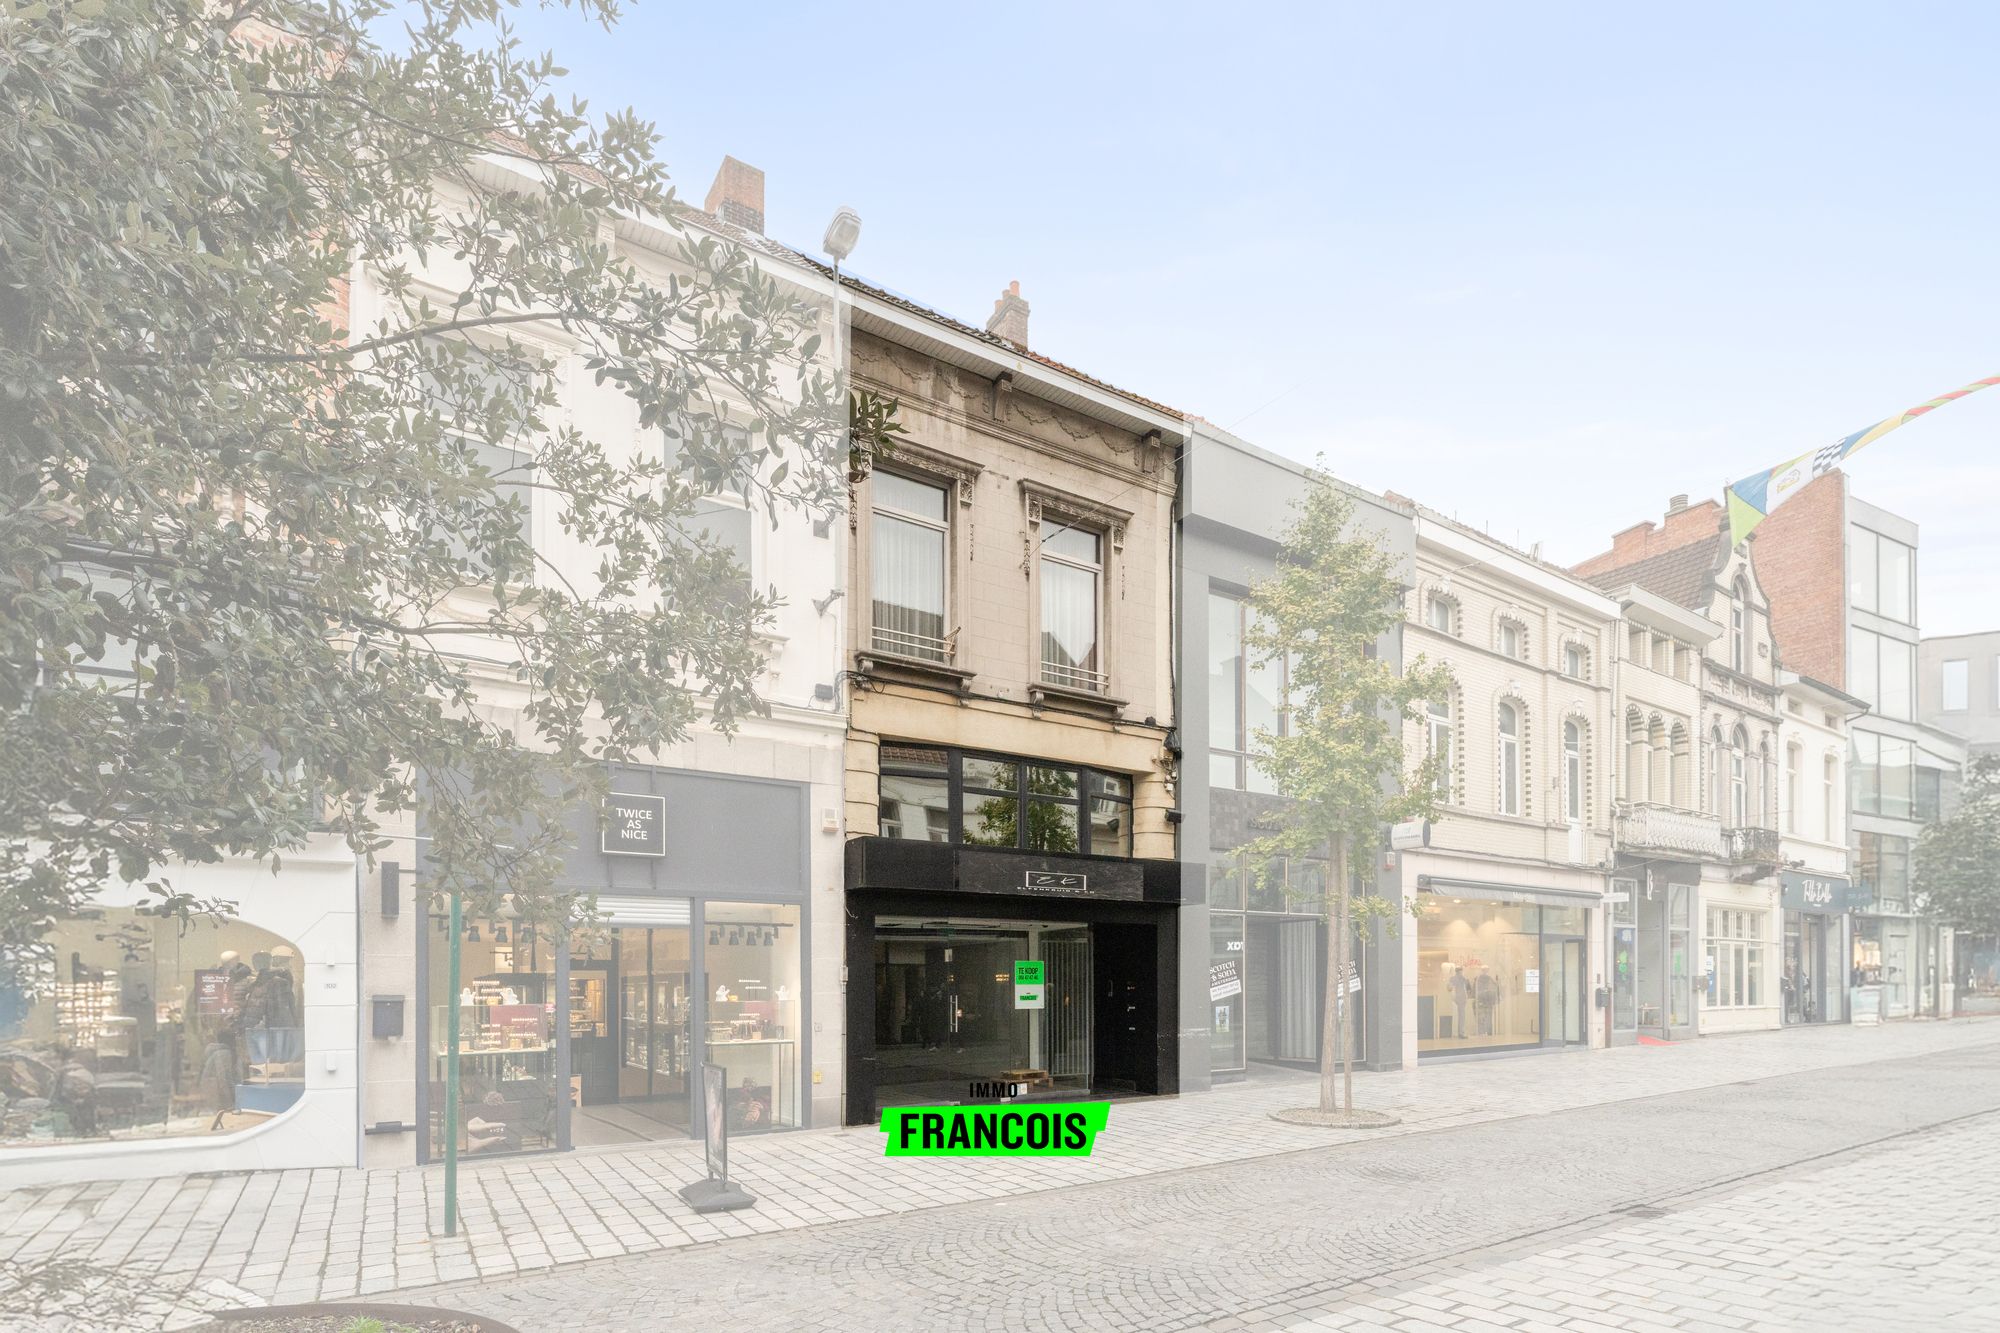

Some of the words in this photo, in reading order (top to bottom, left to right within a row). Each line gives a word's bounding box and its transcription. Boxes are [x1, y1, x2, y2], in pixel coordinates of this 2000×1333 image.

[616, 808, 652, 820] TWICE
[627, 820, 641, 829] AS
[622, 829, 648, 840] NICE
